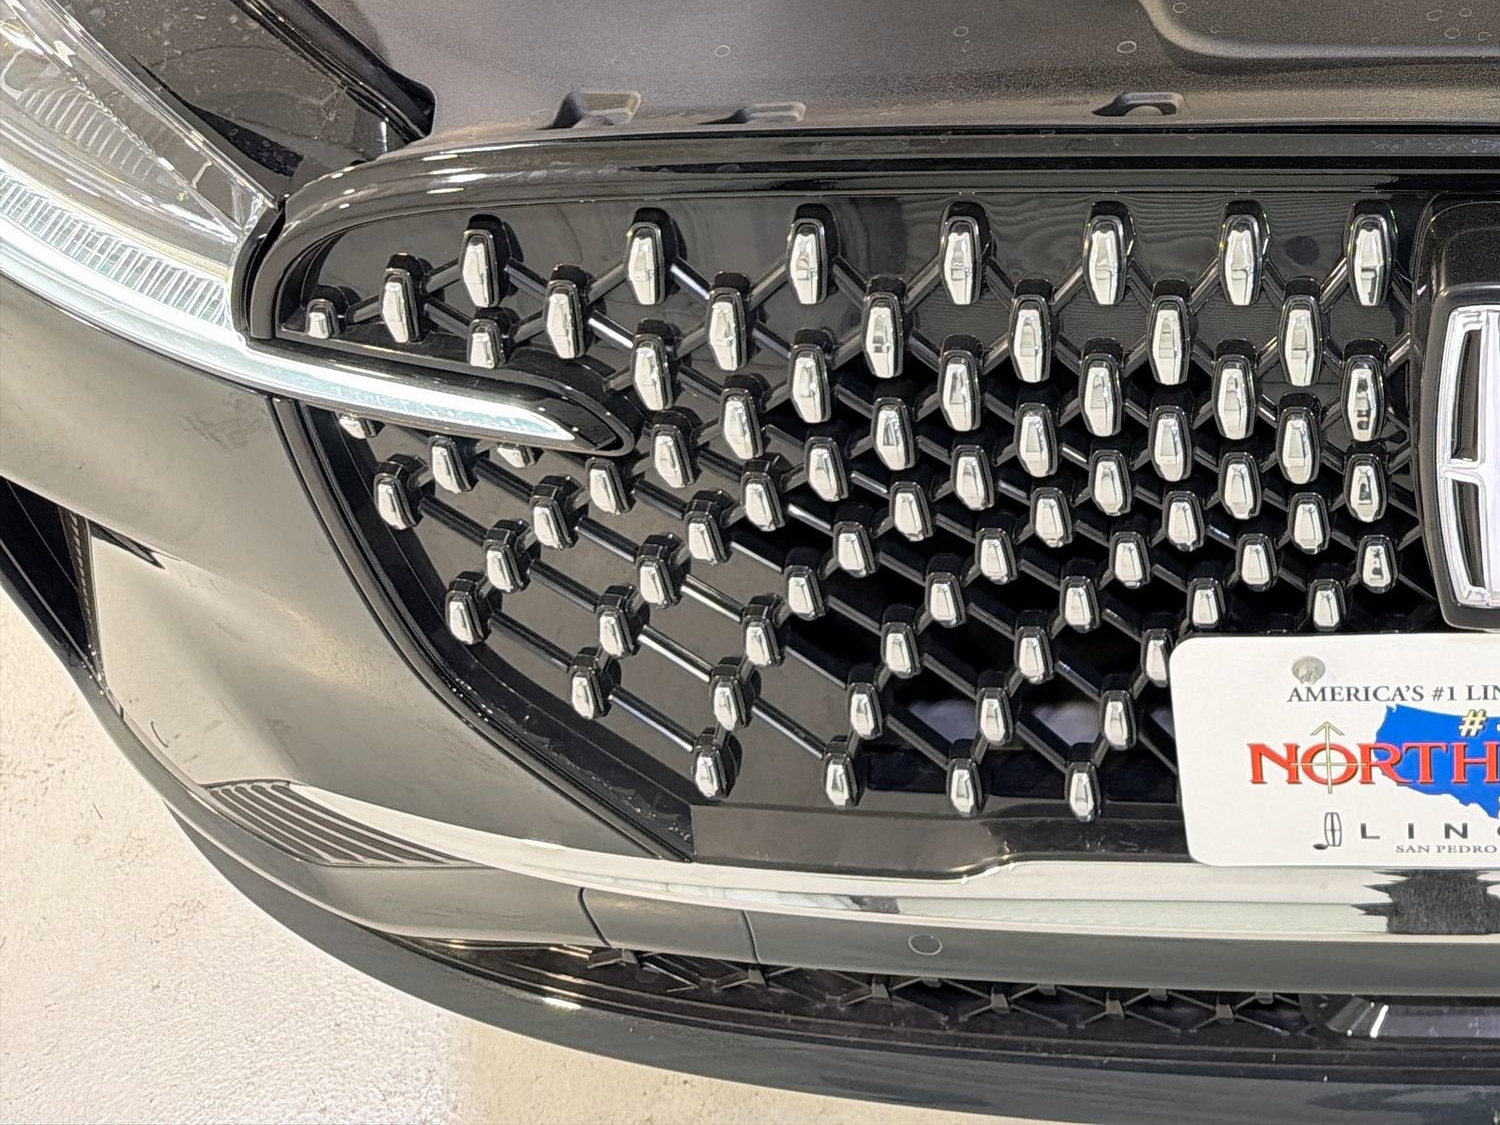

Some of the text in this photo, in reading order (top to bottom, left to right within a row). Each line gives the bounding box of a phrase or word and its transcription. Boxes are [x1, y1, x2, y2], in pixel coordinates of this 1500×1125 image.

[1287, 685, 1424, 702] AMERICA'S
[1432, 686, 1457, 701] #1
[1247, 742, 1500, 785] NORTH
[1396, 845, 1430, 853] SAN
[1437, 845, 1497, 853] PEDRO
